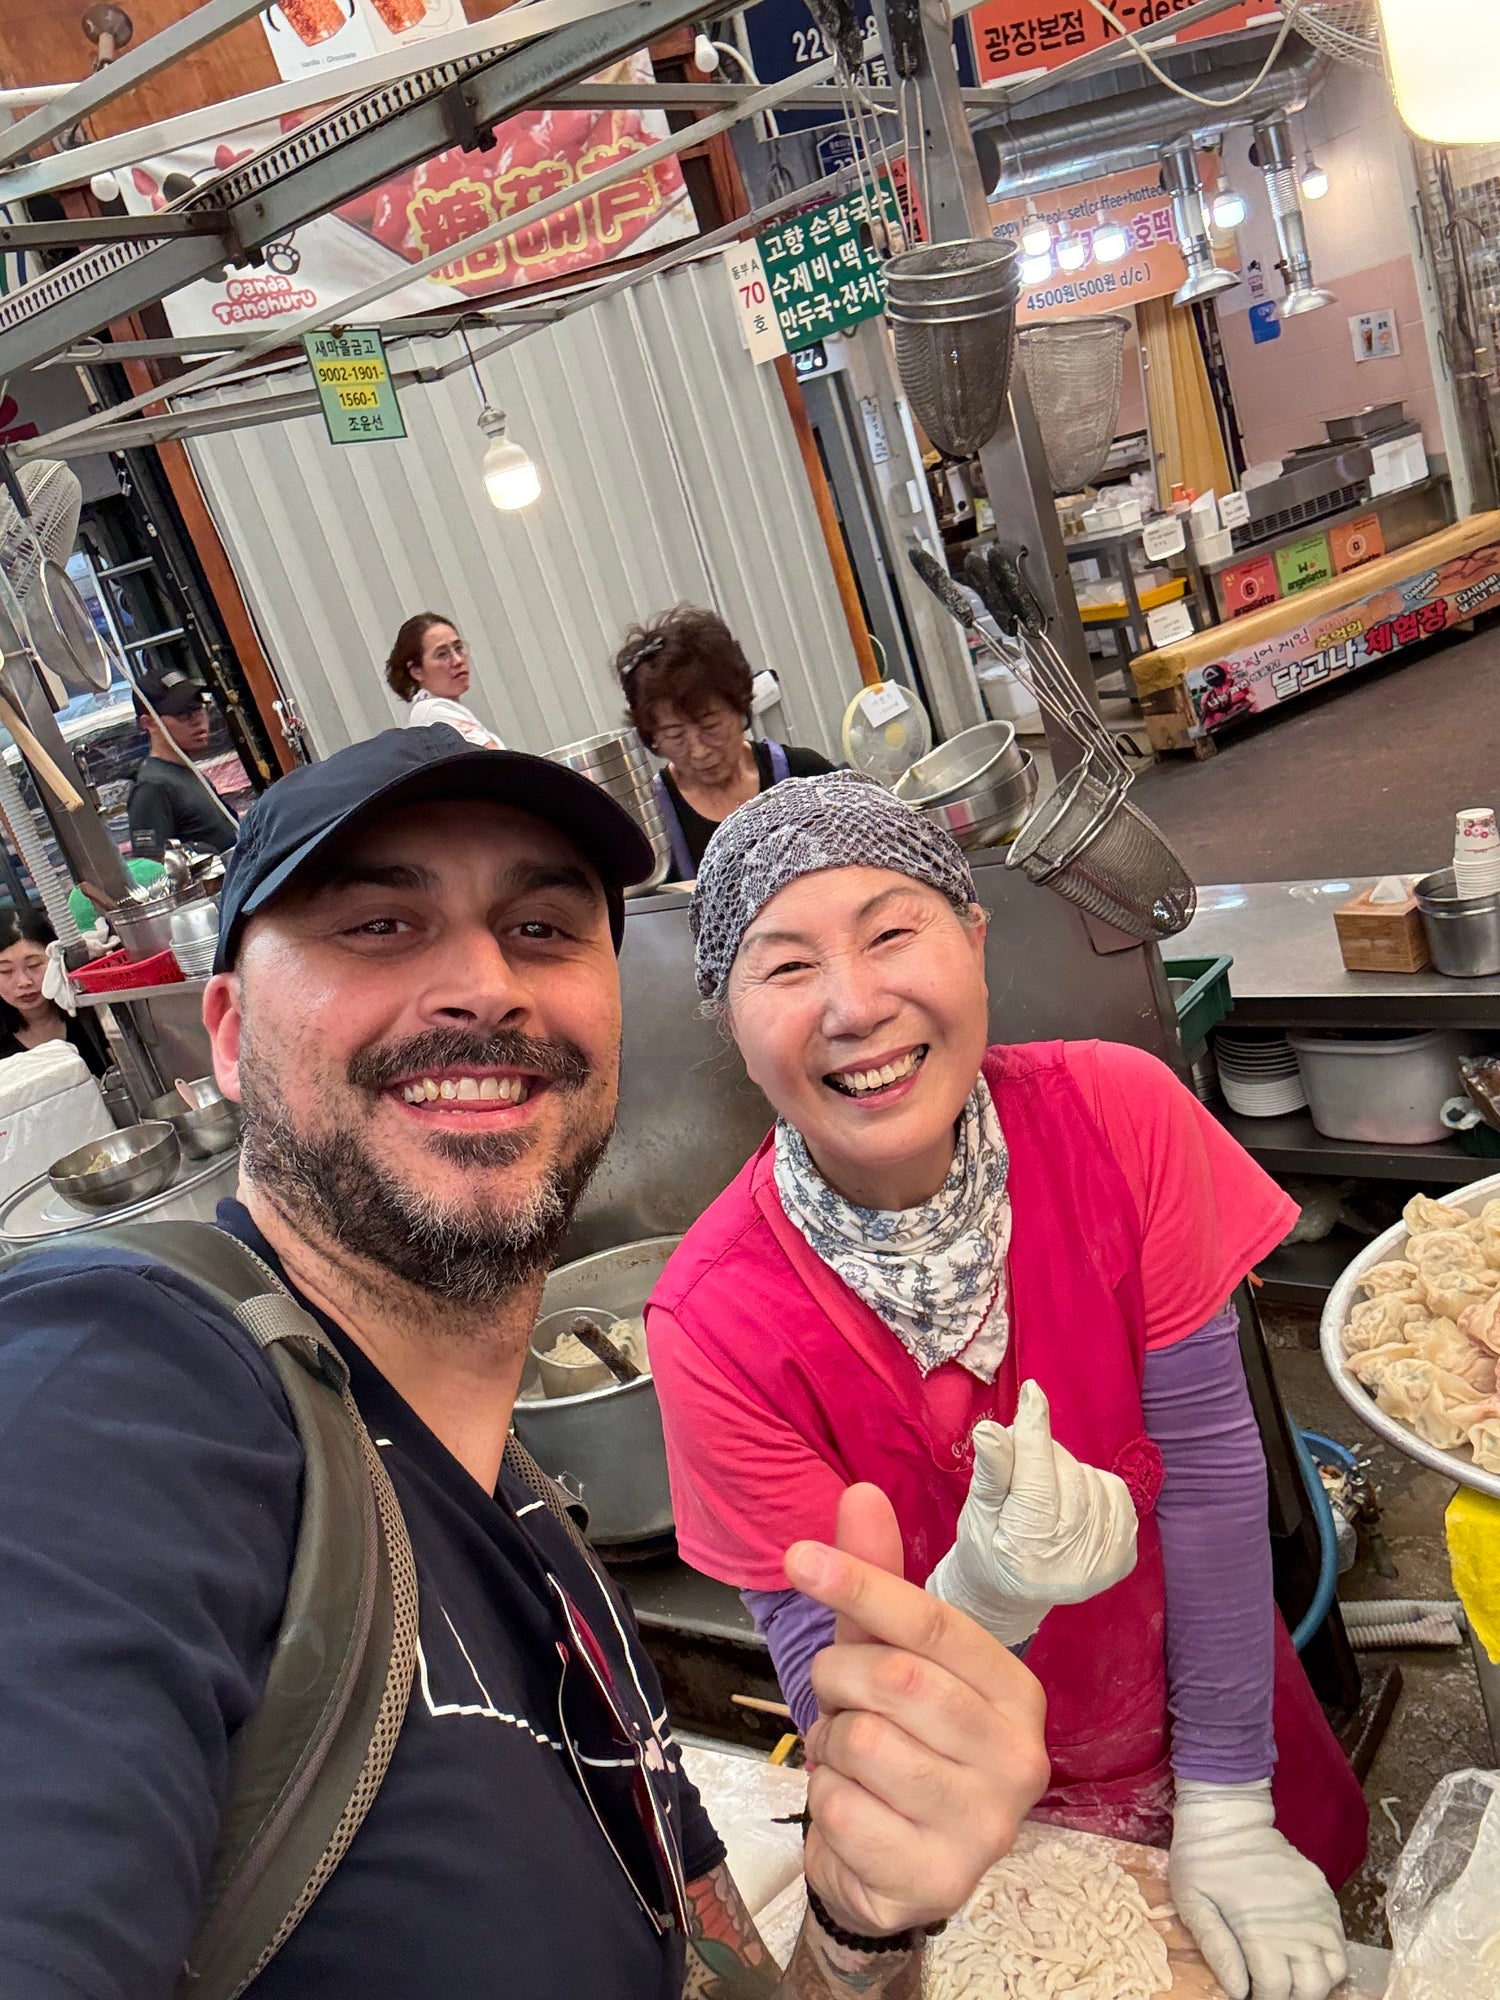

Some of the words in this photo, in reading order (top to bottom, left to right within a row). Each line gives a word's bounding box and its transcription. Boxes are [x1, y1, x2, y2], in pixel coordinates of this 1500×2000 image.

[983, 8, 1086, 63] 광장본점
[763, 225, 805, 264] 고향
[809, 189, 893, 246] 손칼국수
[731, 264, 749, 281] 동부
[750, 258, 761, 272] A
[227, 276, 290, 300] Panda
[738, 280, 766, 309] 70
[214, 289, 317, 324] Tanghuru
[753, 314, 769, 335] 호
[314, 339, 377, 358] 새마을금고
[318, 365, 385, 383] 9002-1901-
[339, 391, 379, 408] 1560-1
[347, 414, 385, 433] 조윤선
[1403, 571, 1438, 601] Dalgona
[1416, 579, 1441, 600] Game
[1278, 627, 1312, 654] 게임
[1314, 619, 1365, 650] 추억의
[1270, 638, 1360, 700] 달고나
[1364, 598, 1448, 656] 체험장
